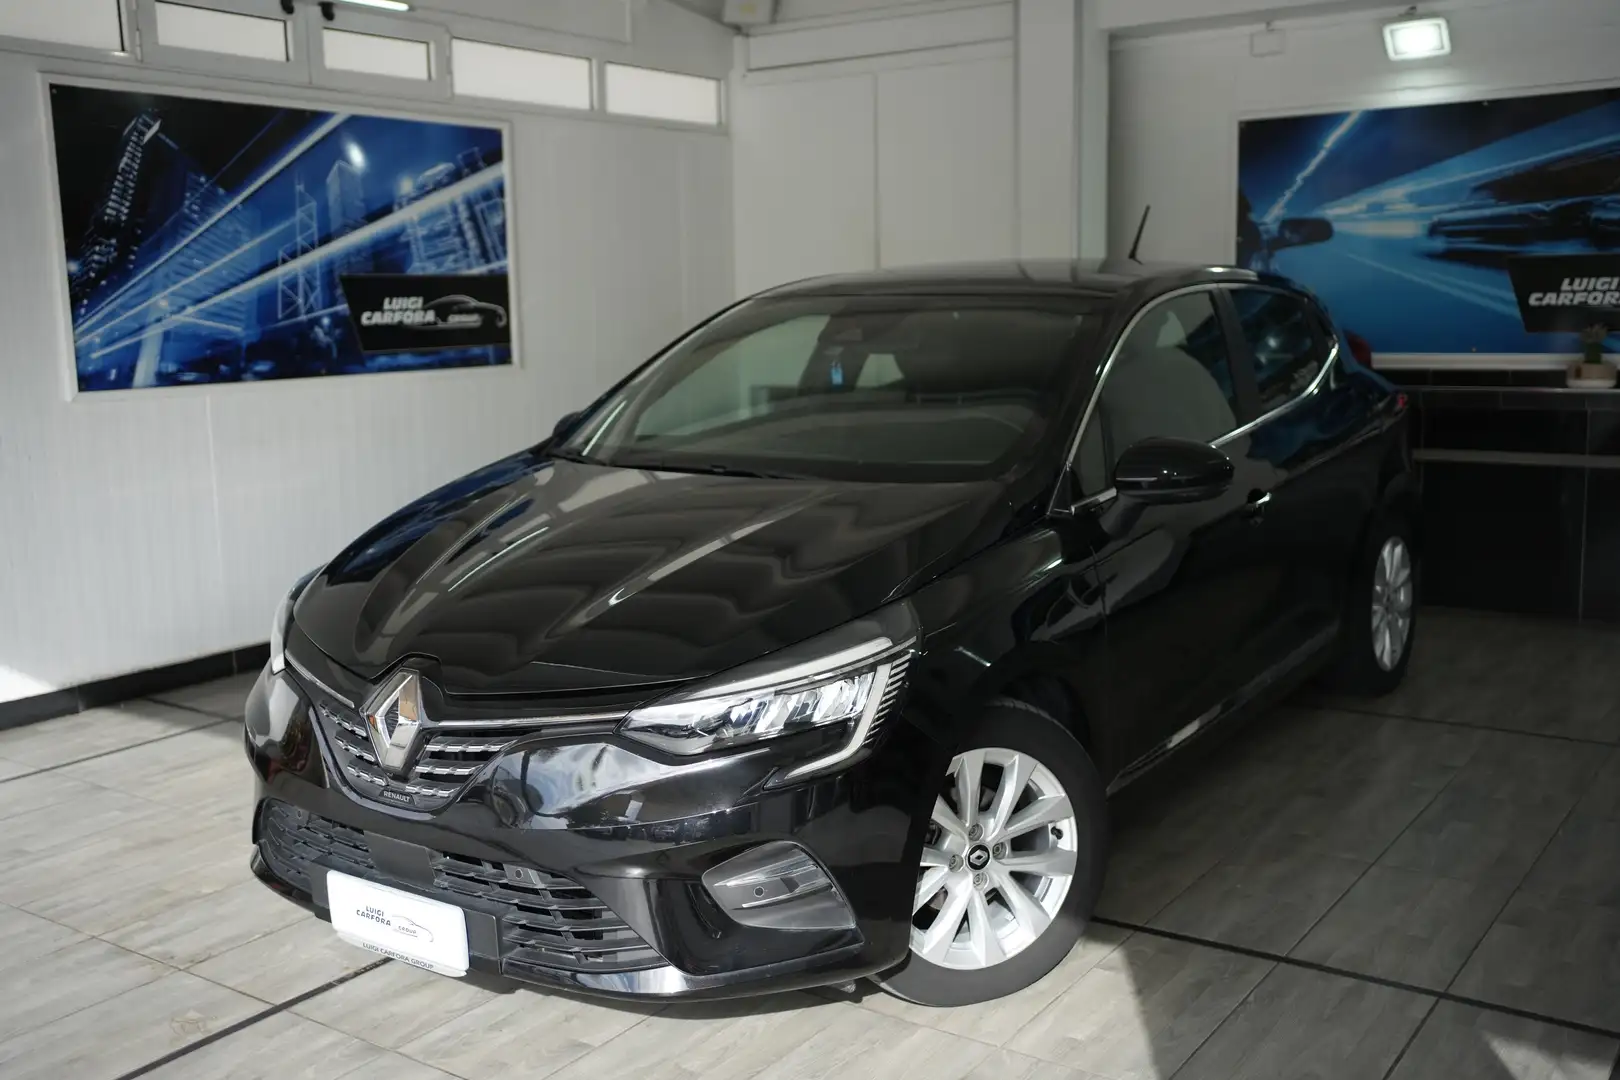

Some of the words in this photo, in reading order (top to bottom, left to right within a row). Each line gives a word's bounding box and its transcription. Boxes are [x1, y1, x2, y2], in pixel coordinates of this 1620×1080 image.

[1561, 277, 1619, 291] LUIGI
[383, 296, 424, 310] LUIGI
[1528, 291, 1620, 306] CARFOR
[361, 310, 436, 326] CARFORA
[383, 790, 410, 802] RENAULT
[356, 909, 391, 926] CARFORA
[365, 905, 385, 917] LUIGI
[411, 958, 434, 970] GROUP
